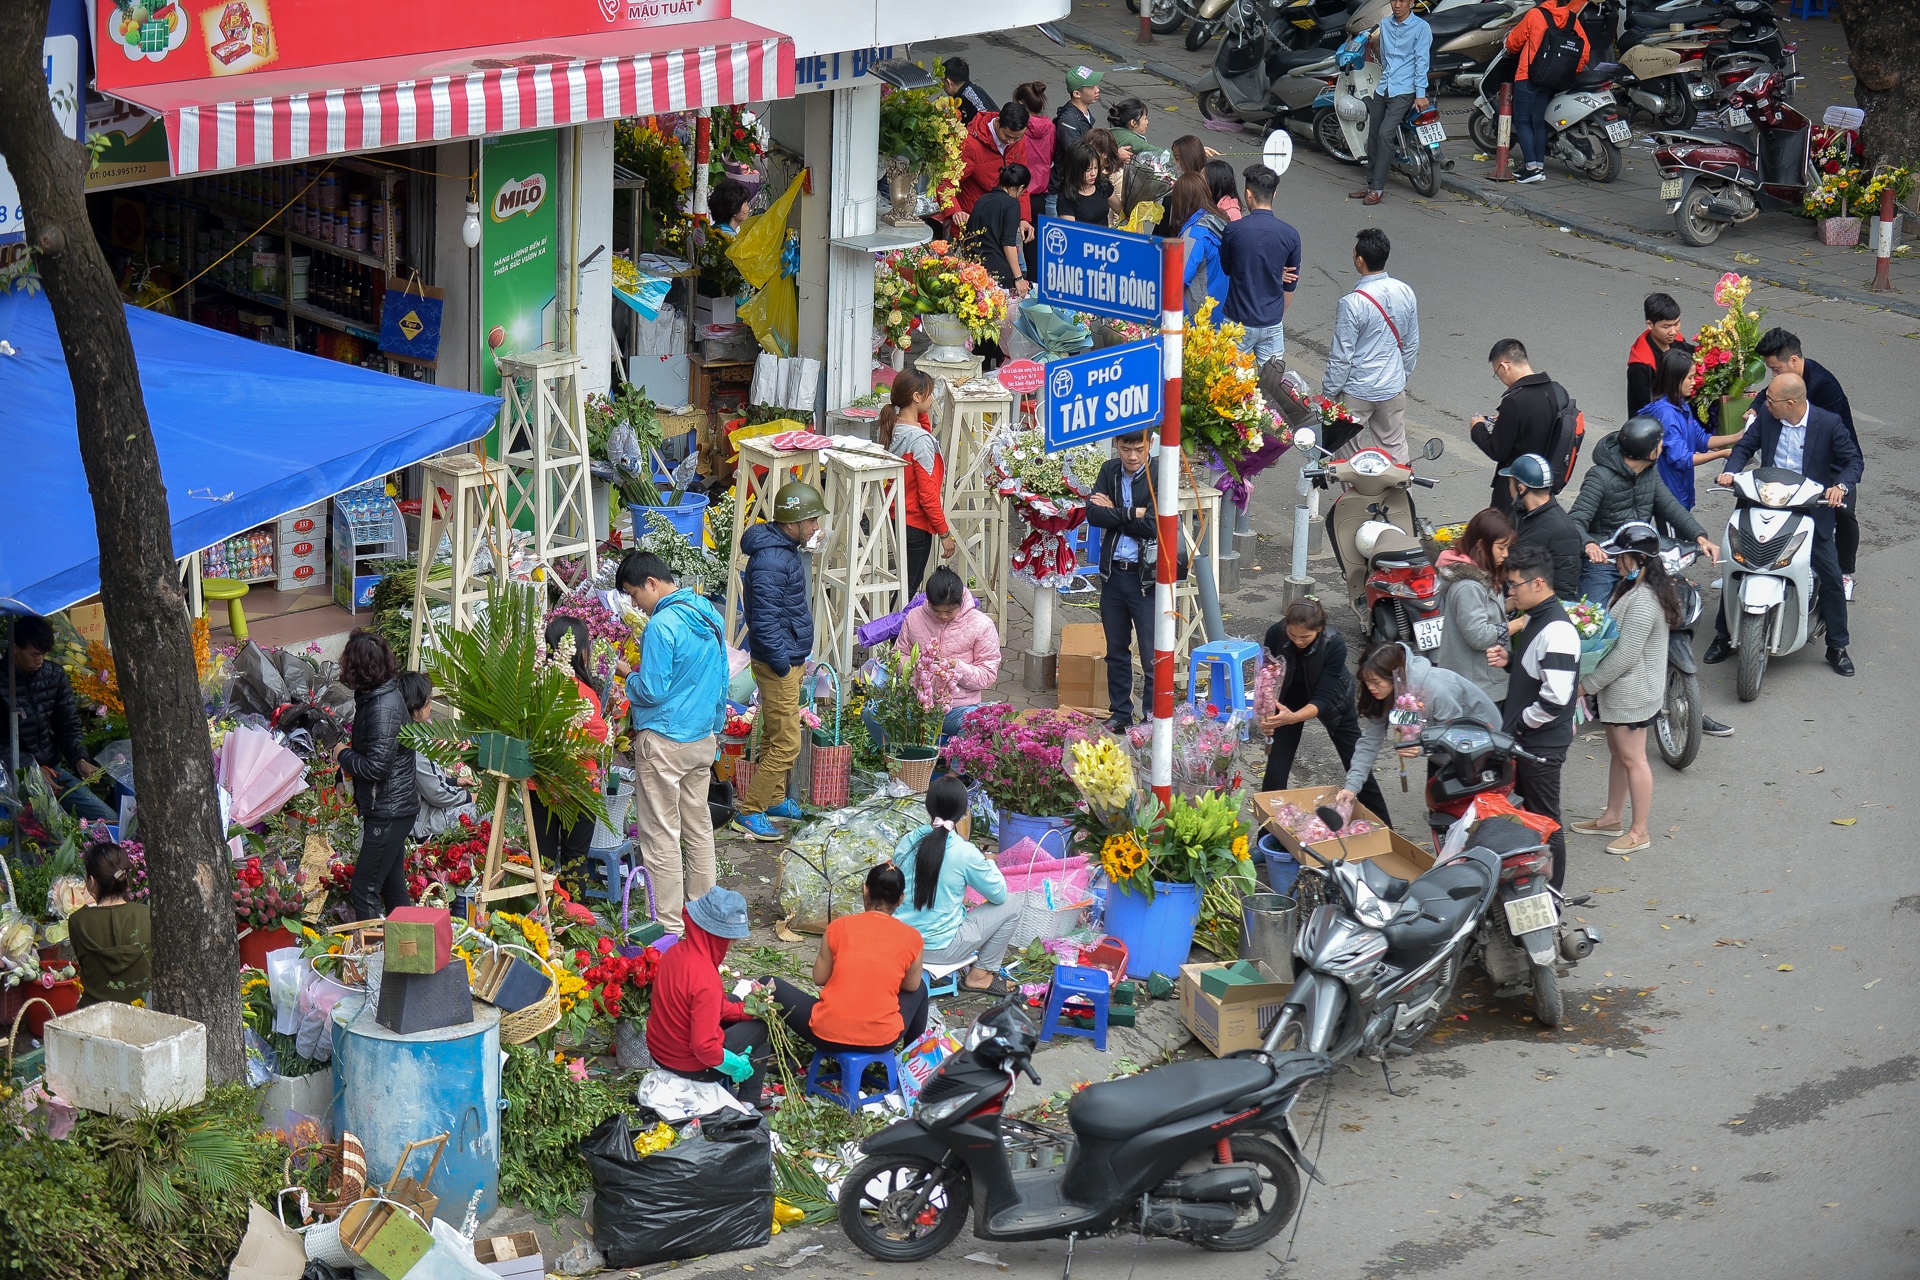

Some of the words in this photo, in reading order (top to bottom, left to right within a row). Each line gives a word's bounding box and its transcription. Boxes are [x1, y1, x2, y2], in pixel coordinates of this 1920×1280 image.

[629, 4, 659, 21] MẬU
[1424, 131, 1442, 143] 1925
[102, 165, 147, 178] 043.9951722
[498, 185, 542, 213] MILO
[538, 247, 546, 256] XA
[1083, 241, 1121, 264] PHỐ
[1047, 257, 1084, 299] ĐẶNG
[1086, 262, 1117, 303] TIẾN
[1118, 270, 1157, 311] ĐÔNG
[1087, 358, 1124, 387] PHỐ
[1060, 393, 1100, 434] TÂY
[1104, 383, 1149, 422] SƠN
[299, 521, 309, 529] 333
[298, 544, 308, 552] 333
[299, 567, 309, 576] 333
[1516, 911, 1551, 932] 6326
